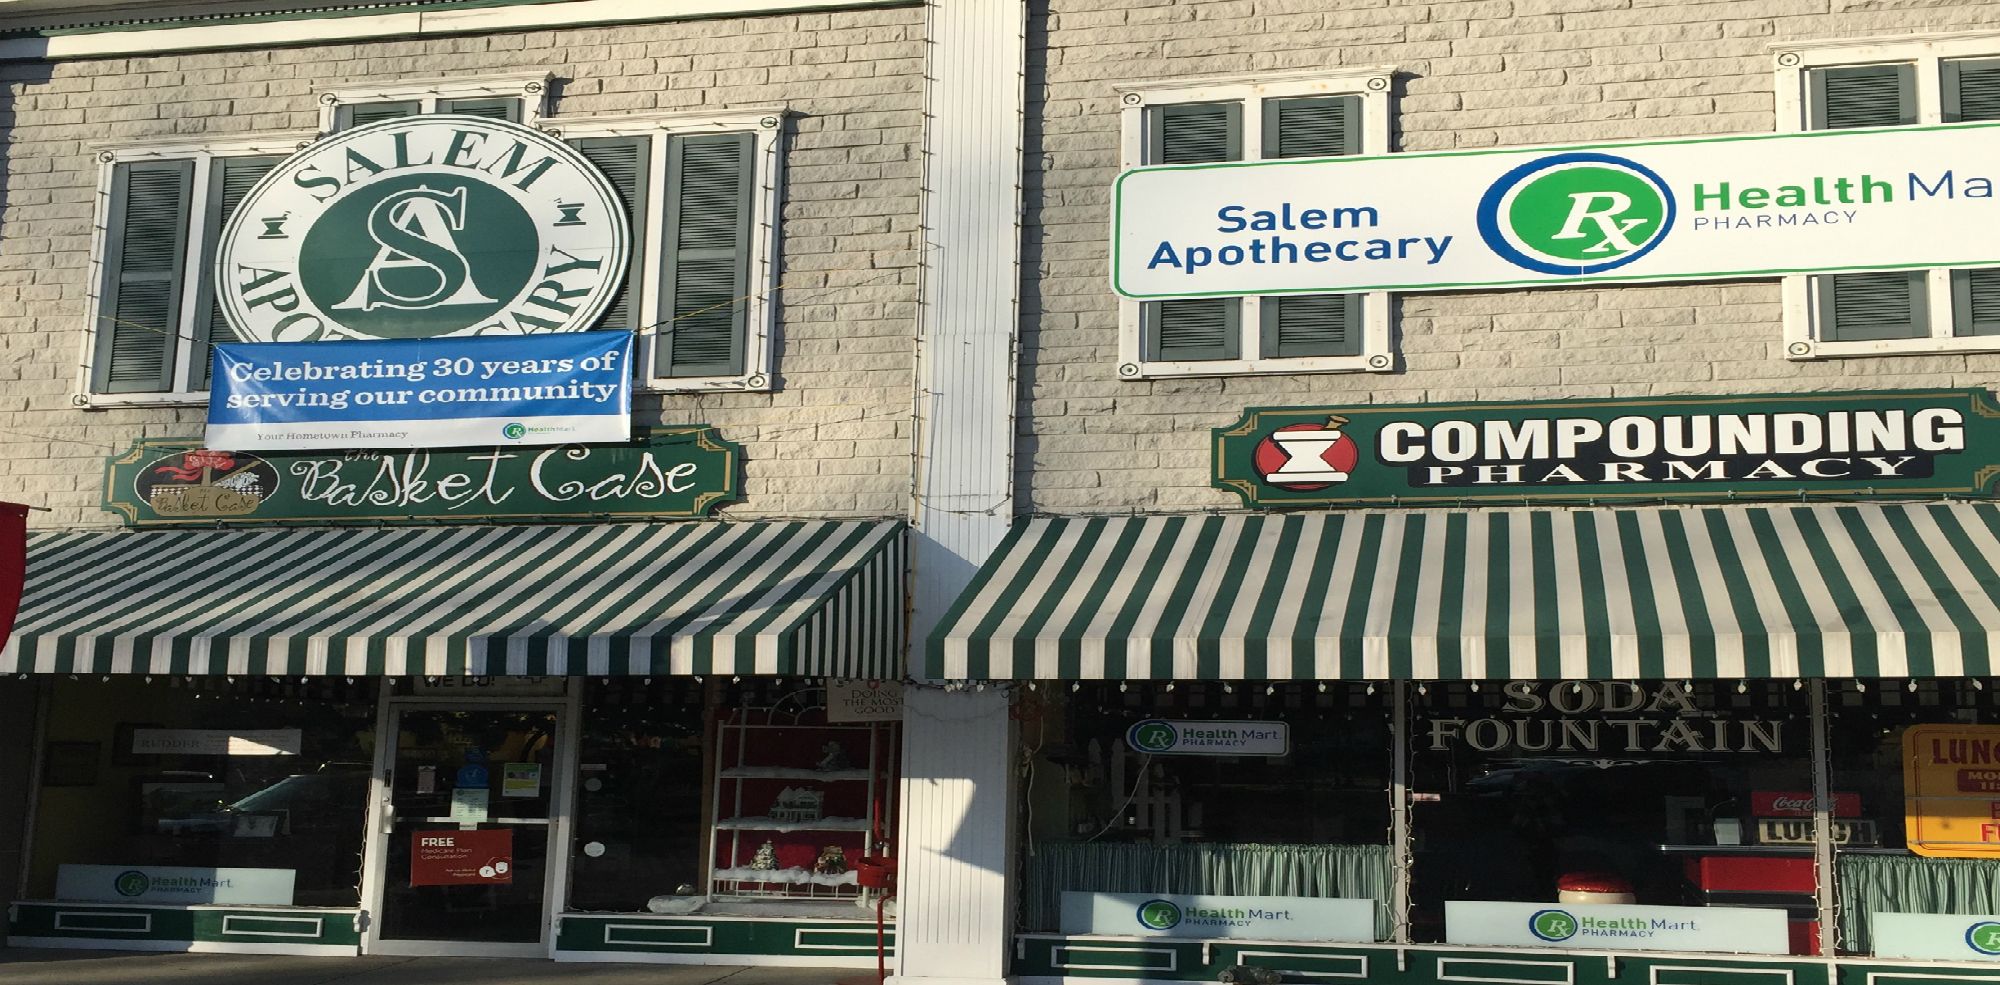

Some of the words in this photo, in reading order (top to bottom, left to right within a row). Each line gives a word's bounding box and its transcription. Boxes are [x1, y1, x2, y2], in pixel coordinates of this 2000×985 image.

[294, 129, 563, 203] SALEM
[1694, 174, 1893, 211] Health
[1217, 202, 1379, 234] Salem
[1694, 210, 1858, 230] PHARMACY
[1147, 234, 1453, 275] Apothecary
[238, 245, 604, 342] APOARY
[230, 358, 426, 383] Celebrating
[432, 357, 474, 378] 30
[482, 357, 574, 381] years
[580, 350, 619, 372] of
[226, 386, 348, 410] serving
[354, 387, 414, 407] our
[418, 380, 618, 404] community
[257, 433, 284, 441] Your
[286, 431, 348, 440] Hometown
[350, 430, 409, 439] Pharmacy
[1380, 407, 1965, 463] COMPOUNDING
[290, 448, 518, 510] Basket
[534, 444, 696, 501] Case
[1424, 456, 1916, 485] PHARMACY
[842, 698, 866, 706] THE
[852, 689, 898, 698] DOING
[1502, 680, 1704, 714] SODA
[855, 706, 895, 714] GOOD
[1183, 727, 1237, 739] Health
[1427, 718, 1783, 753] FOUNTAIN
[1968, 771, 2000, 780] MO
[1767, 821, 1871, 842] LUCH
[421, 837, 455, 847] FREE
[151, 876, 198, 888] Health
[1185, 907, 1244, 919] Health
[1185, 918, 1252, 927] PHARMACY
[1582, 917, 1647, 930] Health
[1582, 929, 1654, 938] PHARMACY
